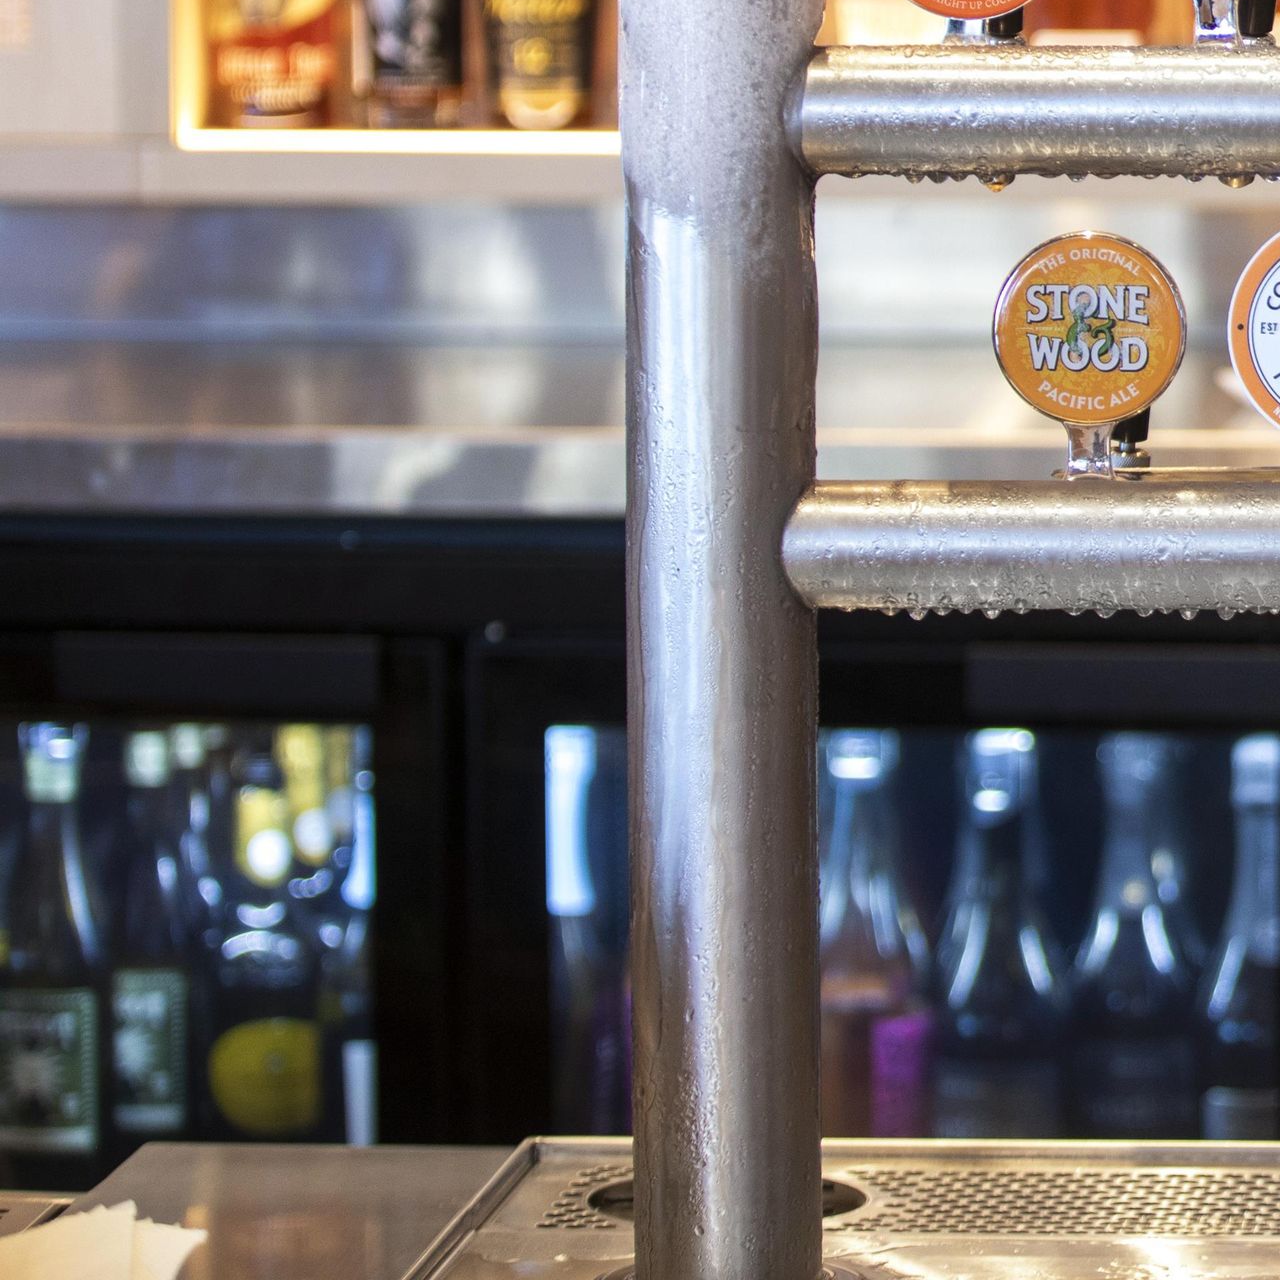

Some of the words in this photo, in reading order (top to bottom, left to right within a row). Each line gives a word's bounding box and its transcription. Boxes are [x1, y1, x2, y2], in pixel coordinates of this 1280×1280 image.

[970, 1, 982, 10] UP
[1038, 253, 1066, 274] THE
[1070, 248, 1141, 276] ORIGINAL
[1026, 284, 1149, 325] STONE
[1261, 322, 1278, 334] EST
[1027, 333, 1148, 372] WOOD
[1038, 380, 1105, 410] PACIFIC
[1110, 382, 1140, 407] ALE
